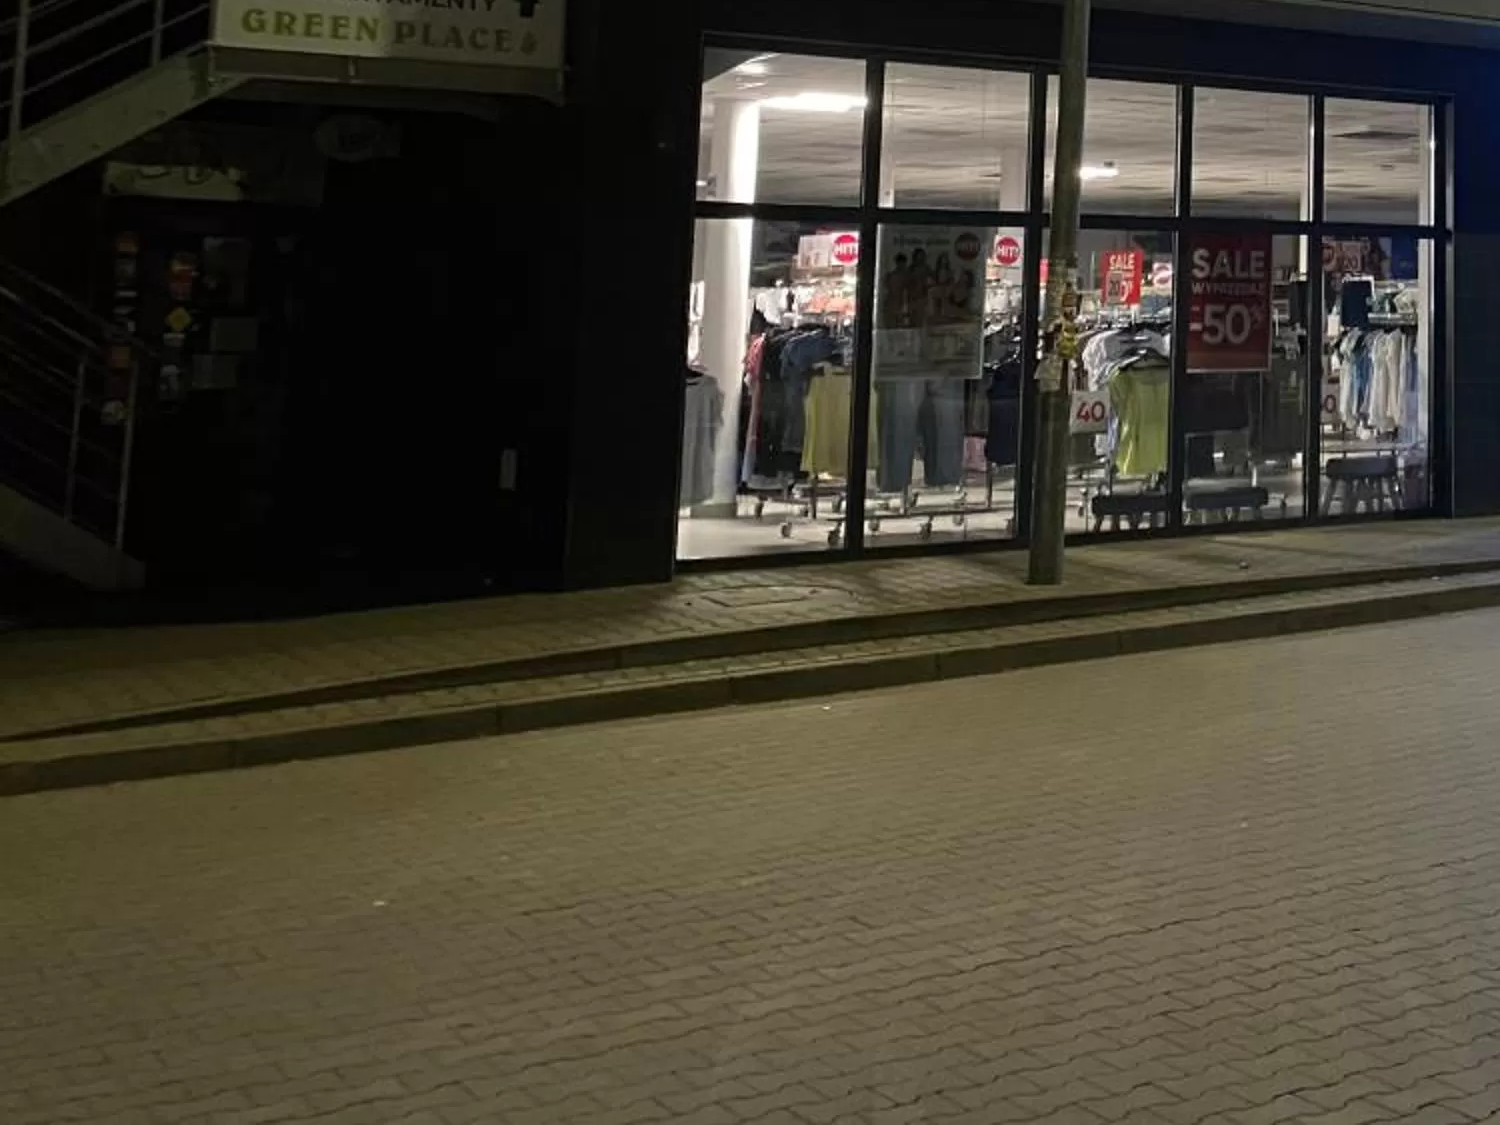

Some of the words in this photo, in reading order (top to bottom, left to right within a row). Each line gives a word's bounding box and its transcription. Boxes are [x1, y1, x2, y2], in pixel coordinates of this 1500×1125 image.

[240, 7, 381, 43] GREEN
[393, 19, 514, 54] PLACE
[1109, 254, 1135, 271] SALE
[1191, 248, 1265, 279] SALE
[1076, 401, 1105, 422] 40
